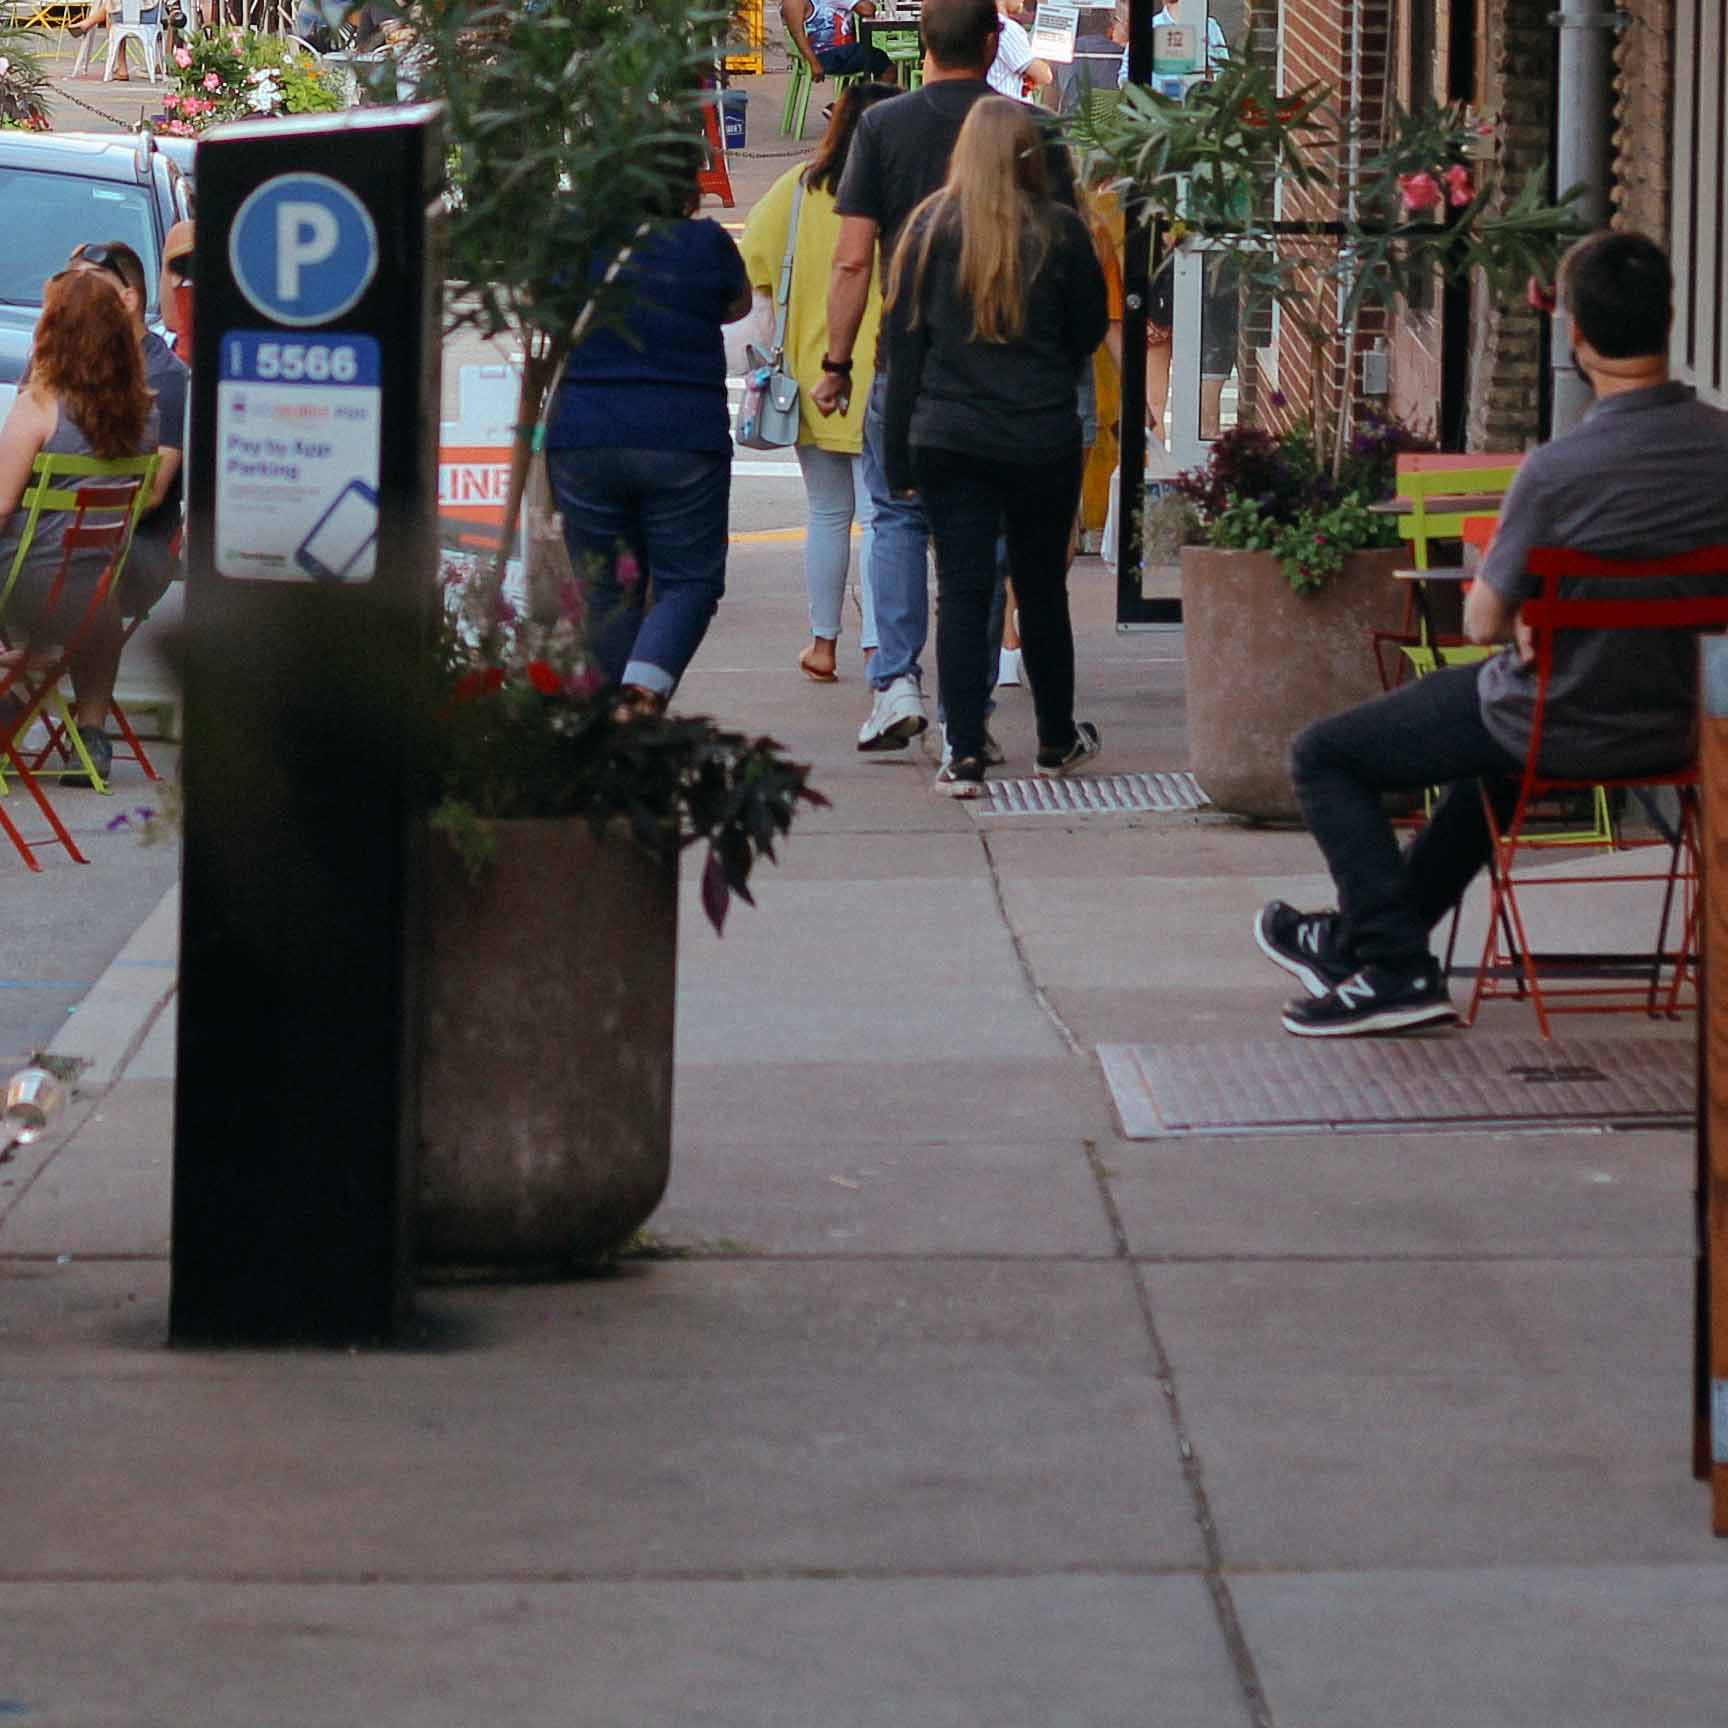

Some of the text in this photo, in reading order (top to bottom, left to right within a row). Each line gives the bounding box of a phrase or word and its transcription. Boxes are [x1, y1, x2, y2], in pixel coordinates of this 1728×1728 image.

[275, 201, 341, 302] P
[256, 342, 358, 382] 5566
[227, 434, 262, 457] Pay
[227, 459, 299, 481] Parking
